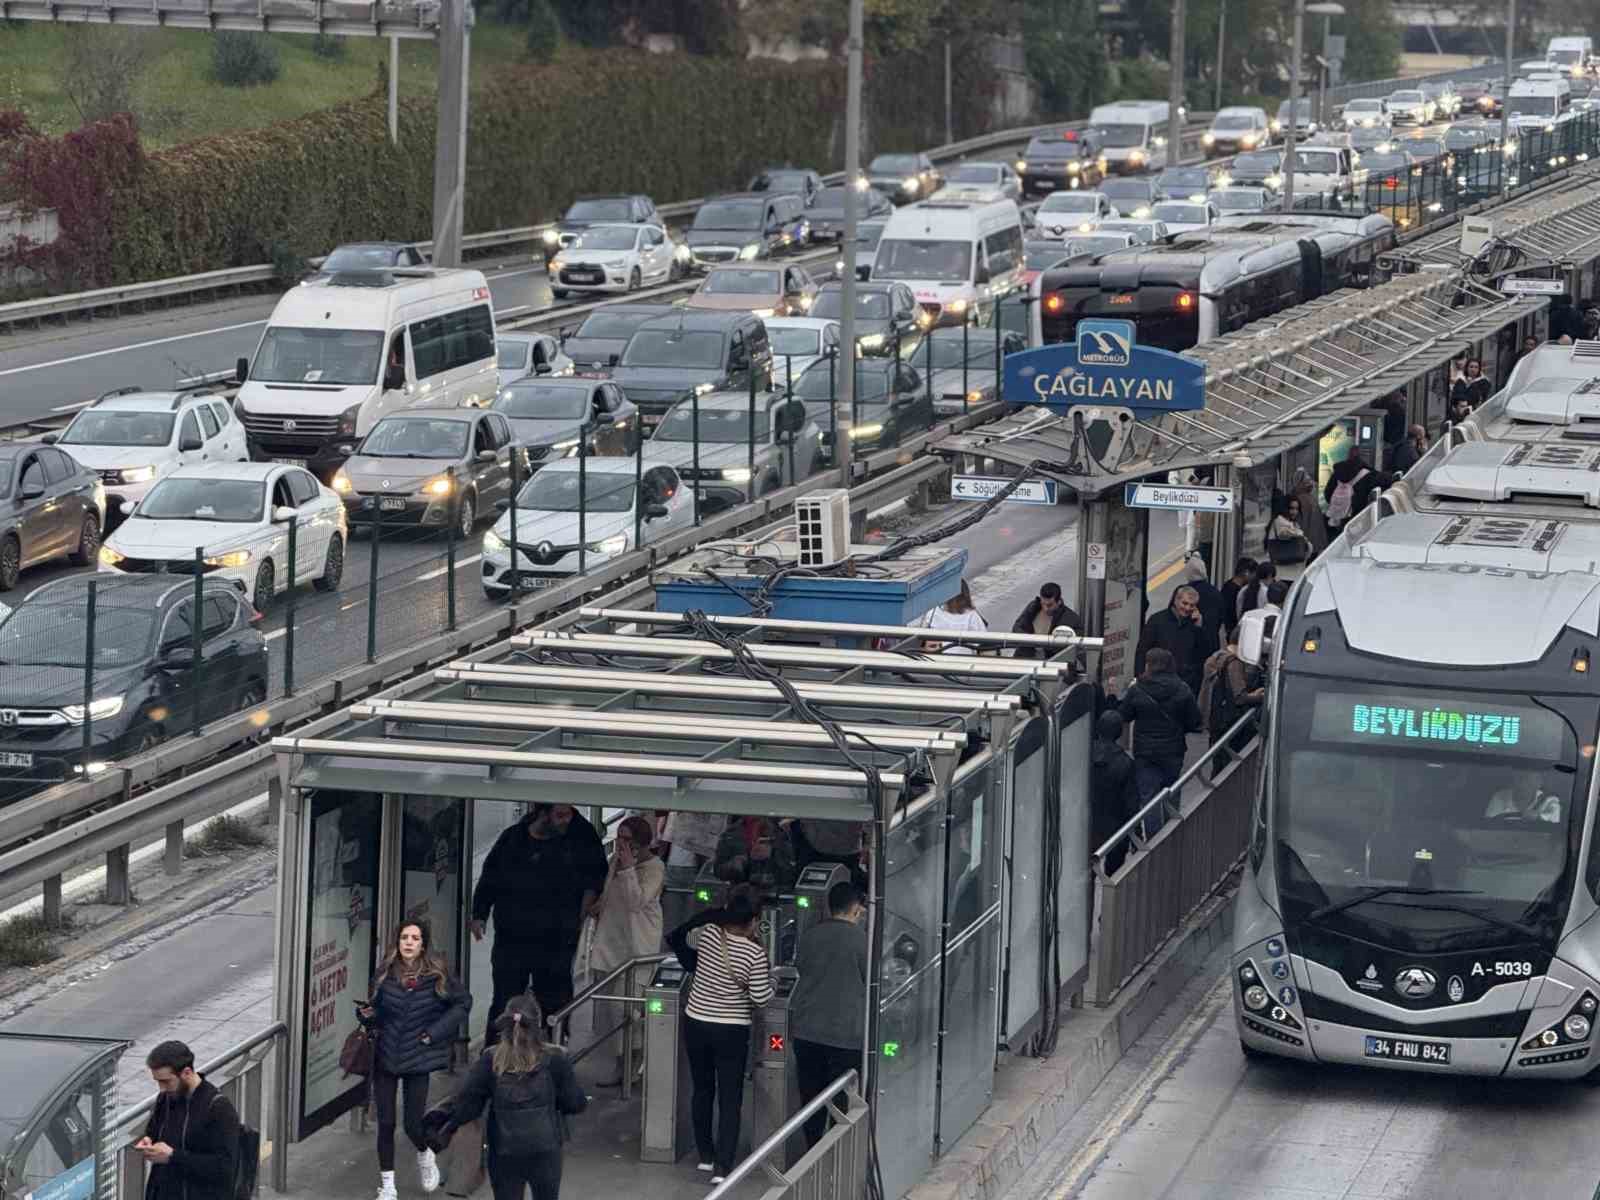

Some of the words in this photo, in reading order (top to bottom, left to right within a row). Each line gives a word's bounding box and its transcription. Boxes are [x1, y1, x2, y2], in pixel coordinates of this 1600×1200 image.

[1083, 354, 1126, 363] METROBÜS
[1033, 372, 1174, 402] ÇAĞLAYAN
[1153, 490, 1199, 505] Beylikdüzü
[319, 966, 348, 1002] METRO
[1375, 1039, 1390, 1055] 34
[1394, 1042, 1419, 1058] FNU
[1422, 1044, 1447, 1061] 842
